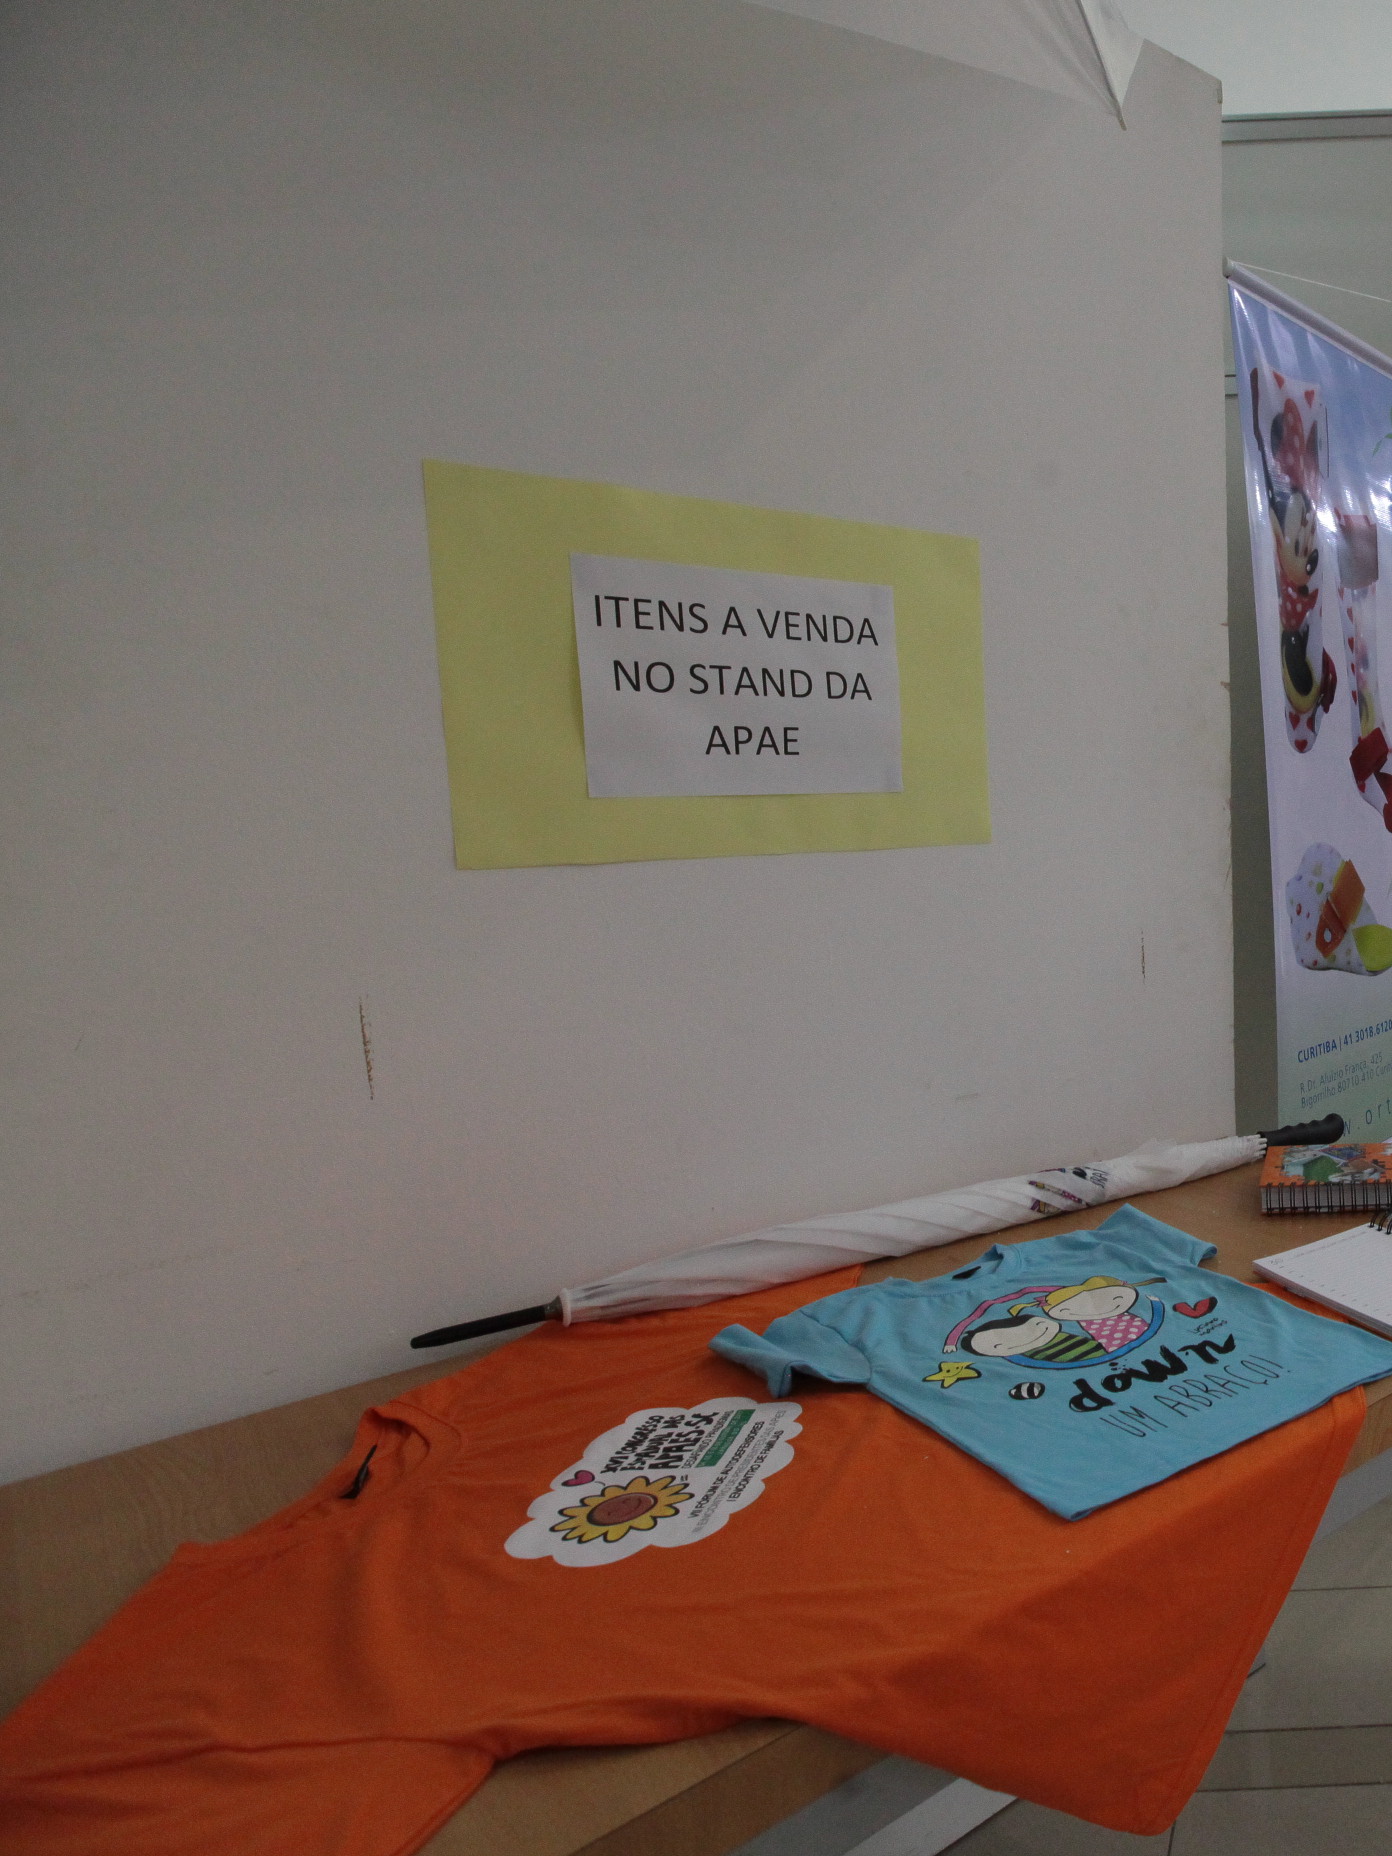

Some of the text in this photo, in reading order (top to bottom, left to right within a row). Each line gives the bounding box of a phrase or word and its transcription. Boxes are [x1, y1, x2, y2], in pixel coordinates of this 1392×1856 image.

[594, 594, 879, 646] ITENS A VENDA
[613, 659, 873, 701] NO STAND DA
[705, 725, 800, 756] APAE
[1297, 1038, 1338, 1063] CURITIBA
[1343, 1033, 1353, 1046] 41
[1355, 1019, 1392, 1043] 3018.6120
[1069, 1333, 1236, 1413] down
[1100, 1354, 1291, 1438] UM ABRAÇO!
